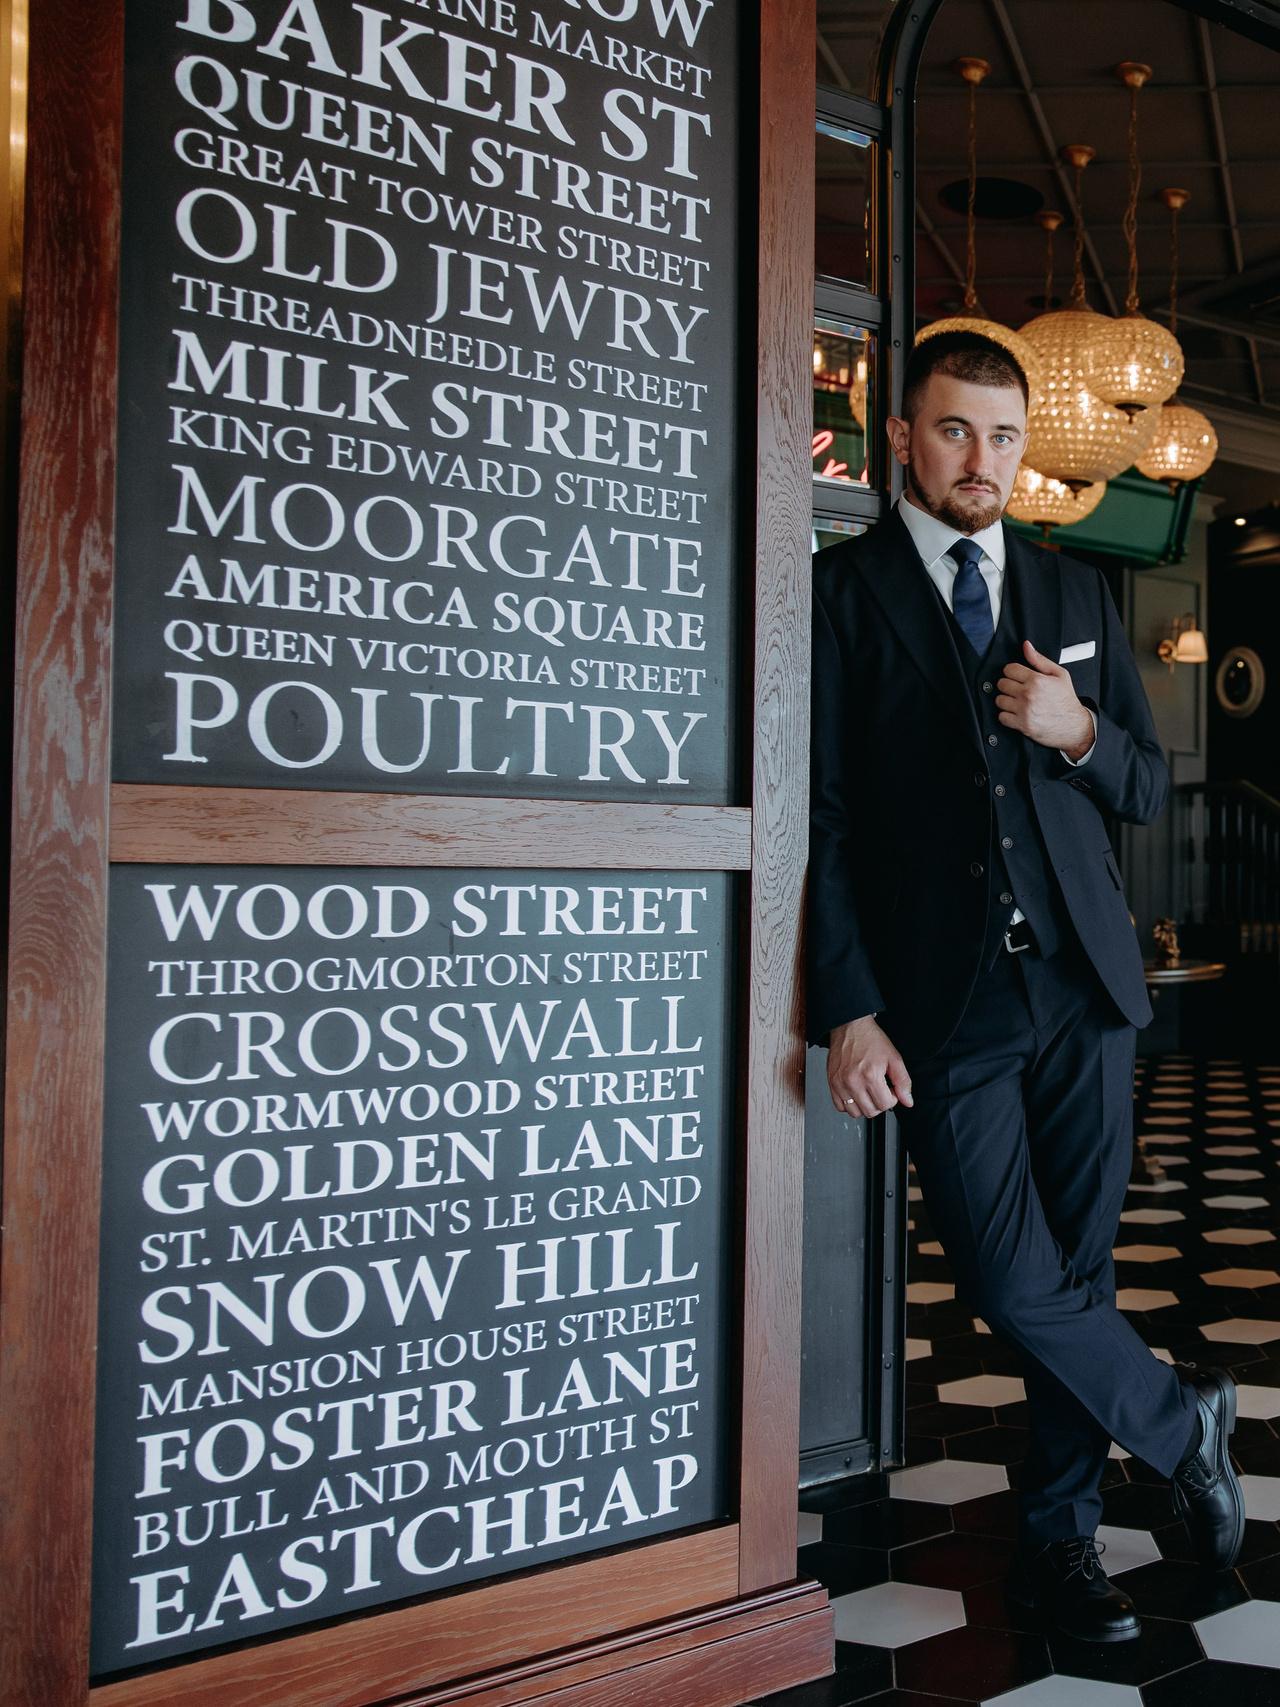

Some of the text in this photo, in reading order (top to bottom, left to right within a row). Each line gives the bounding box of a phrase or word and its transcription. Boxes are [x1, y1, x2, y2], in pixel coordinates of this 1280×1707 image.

[176, 0, 712, 181] BAKER ST
[529, 10, 712, 99] MARKET
[174, 128, 711, 292] GREAT TOWER STREET
[175, 55, 711, 243] QUEEN STREET
[176, 187, 710, 365] OLD JEWRY
[167, 329, 410, 431] MILK
[430, 382, 708, 480] STREET
[172, 273, 708, 413] THREADNEEDLE STREET
[168, 406, 708, 525] KING EDWARD STREET
[167, 463, 706, 599] MOORGATE
[163, 619, 707, 697] QUEEN VICTORIA STREET
[164, 554, 707, 652] AMERICA SQUARE
[162, 671, 708, 785] POULTRY
[143, 883, 708, 942] WOOD STREET
[148, 949, 708, 997] THROGMORTON STREET
[140, 1064, 705, 1143] WORMWOOD STREET
[148, 995, 703, 1085] CROSSWALL
[139, 1174, 703, 1273] ST. MARTIN'S LE GRAND
[141, 1110, 704, 1215] GOLDEN LANE
[137, 1221, 699, 1364] SNOW HILL
[134, 1337, 700, 1499] FOSTER LANE
[136, 1293, 700, 1420] MANSION HOUSE STREET
[132, 1400, 699, 1558] BULL AND MOUTH ST
[125, 1453, 699, 1649] EASTCHEAP
